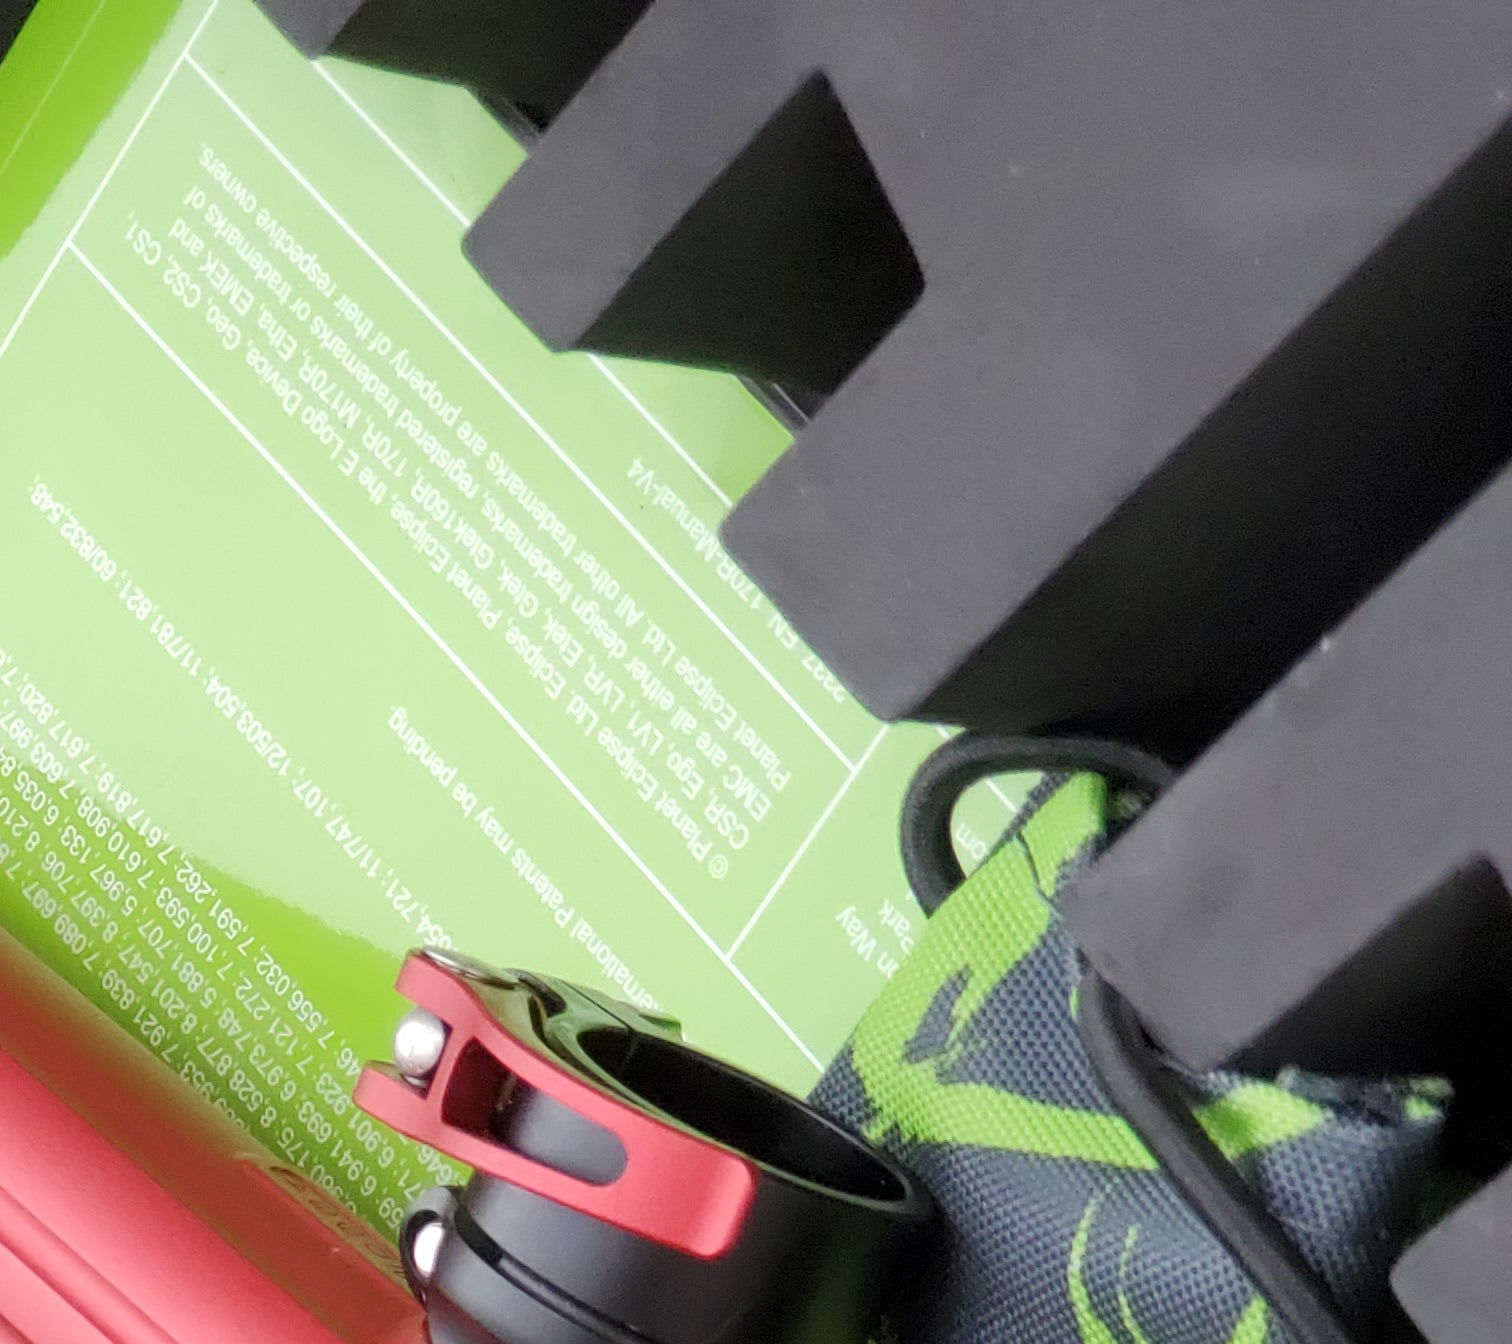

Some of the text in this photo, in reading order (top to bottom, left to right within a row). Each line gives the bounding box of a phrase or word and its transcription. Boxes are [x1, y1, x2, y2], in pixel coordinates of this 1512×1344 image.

[125, 213, 162, 265] CS1,
[164, 255, 201, 308] CS2,
[206, 298, 241, 350] Geo,
[246, 340, 303, 416] Device,
[200, 144, 791, 791] Planet Eclipse Ltd. All other trademarks are property of their respective owners.
[302, 406, 344, 460] Logo
[339, 448, 359, 476] E
[29, 476, 116, 581] 60/832,548;
[168, 218, 749, 849] CSR, Ego, LV1, LVR, Etek, Gtek, Gtek160R, 170R, M170R, Etha, EMEK and
[184, 187, 771, 822] EMC are all either design trademarks, registered trademarks or trademarks of
[359, 467, 387, 504] the
[391, 494, 451, 573] Eclipse,
[116, 571, 202, 676] 11/781,821;
[446, 562, 502, 630] Planet
[506, 617, 567, 699] Eclipse,
[17, 674, 96, 775] 7,617,820;
[203, 668, 291, 776] 12/503,504;
[566, 690, 599, 736] Ltd.
[96, 763, 175, 865] 7,617,819;
[597, 726, 659, 802] Eclipse
[59, 817, 137, 916] 5,967,133;
[78, 796, 154, 889] 7,610,908;
[292, 768, 380, 877] 11/747,107;
[388, 707, 668, 1014] ernational Patents may be pending.
[655, 790, 713, 861] Planet
[22, 870, 100, 971] 7,089,697;
[41, 844, 118, 943] 8,397,706;
[154, 879, 233, 981] 7,100,593;
[175, 854, 254, 956] 7,591,262;
[836, 906, 877, 961] Way
[118, 933, 197, 1034] 8,201,547;
[137, 908, 217, 1008] 5,881,707;
[254, 945, 334, 1049] 7,556,032;
[99, 961, 179, 1062] 7,921,839;
[216, 1000, 297, 1101] 6,973,748;
[234, 972, 314, 1076] 7,121,272;
[196, 1025, 277, 1128] 8,528,877;
[316, 1065, 395, 1168] 6,901,923;
[296, 1093, 377, 1196] 6,941,693;
